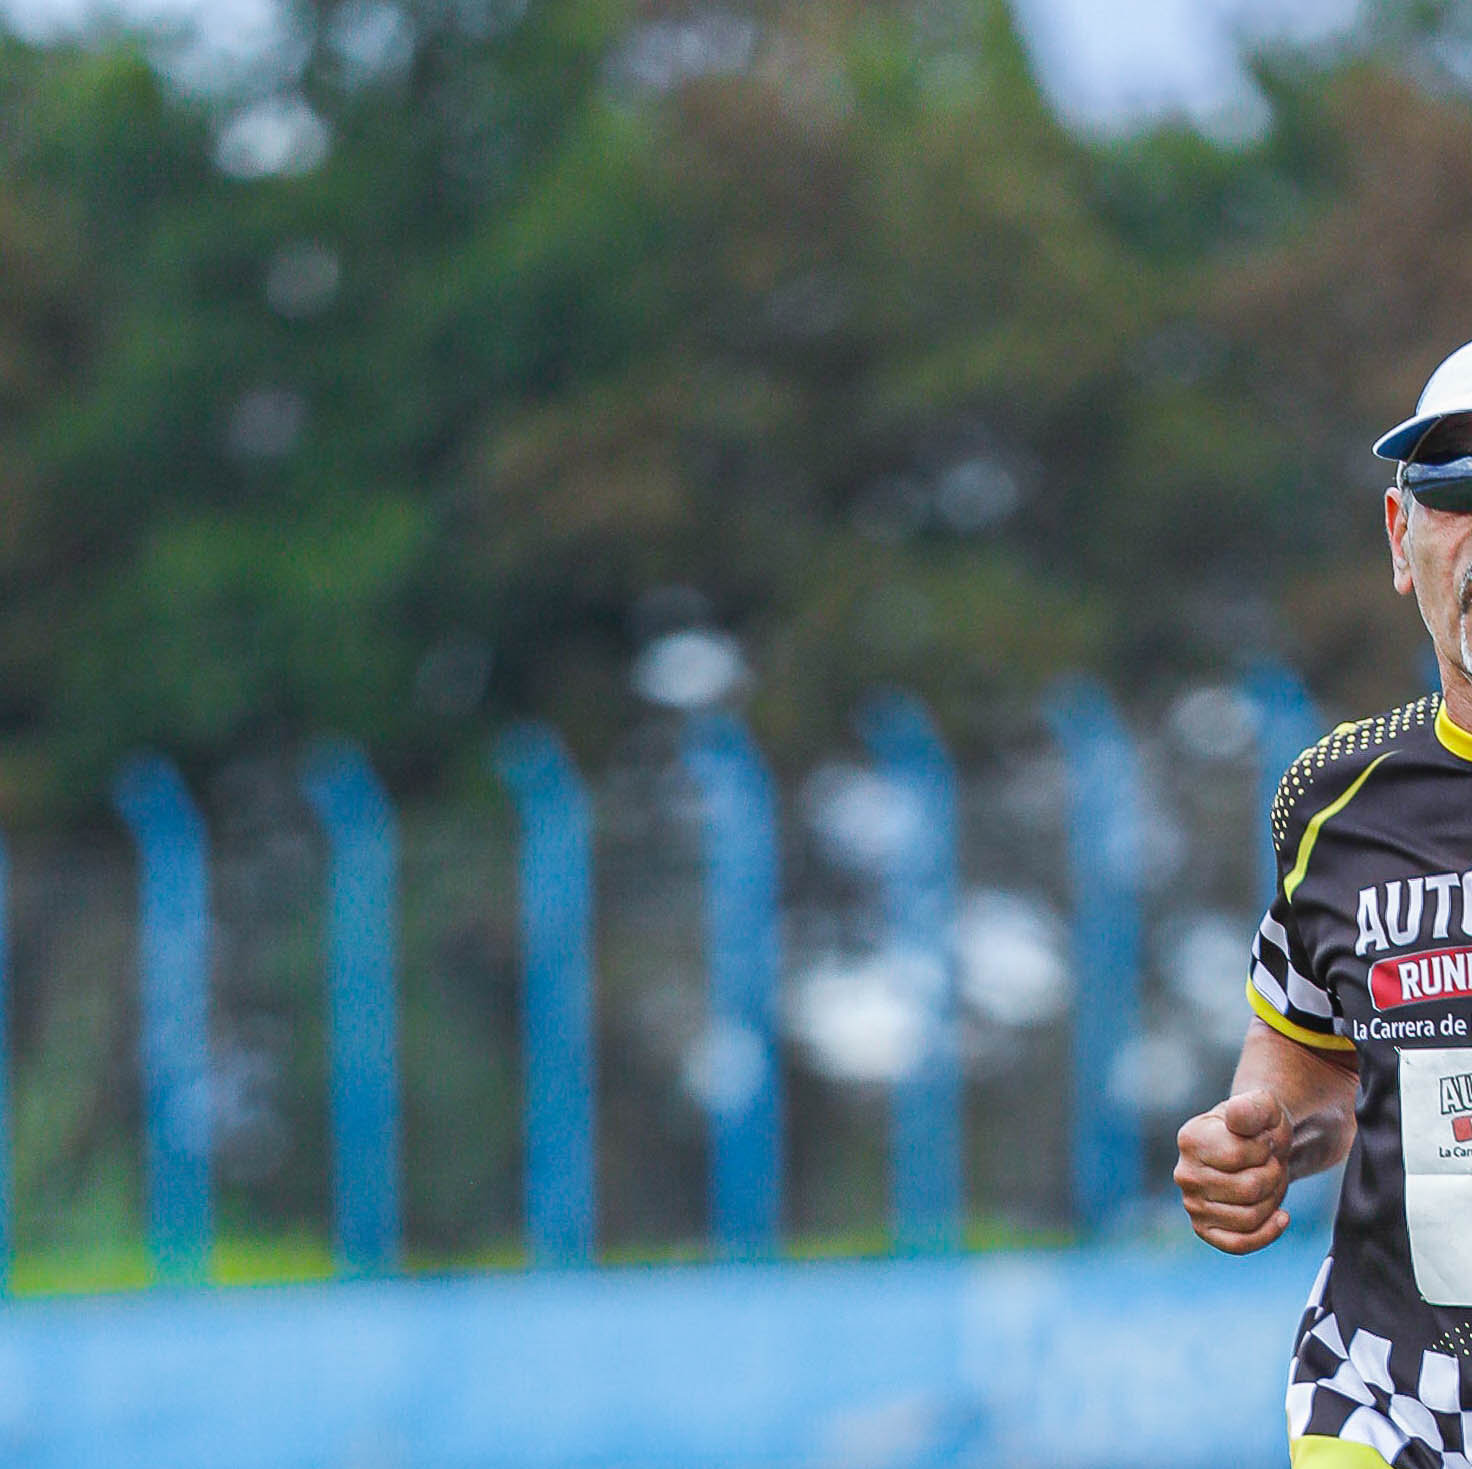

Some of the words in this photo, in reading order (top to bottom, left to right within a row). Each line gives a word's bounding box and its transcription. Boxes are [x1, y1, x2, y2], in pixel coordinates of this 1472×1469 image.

[1353, 1019, 1368, 1041] La
[1370, 1017, 1435, 1039] Carrera
[1440, 1013, 1467, 1036] de
[1439, 1147, 1452, 1158] La
